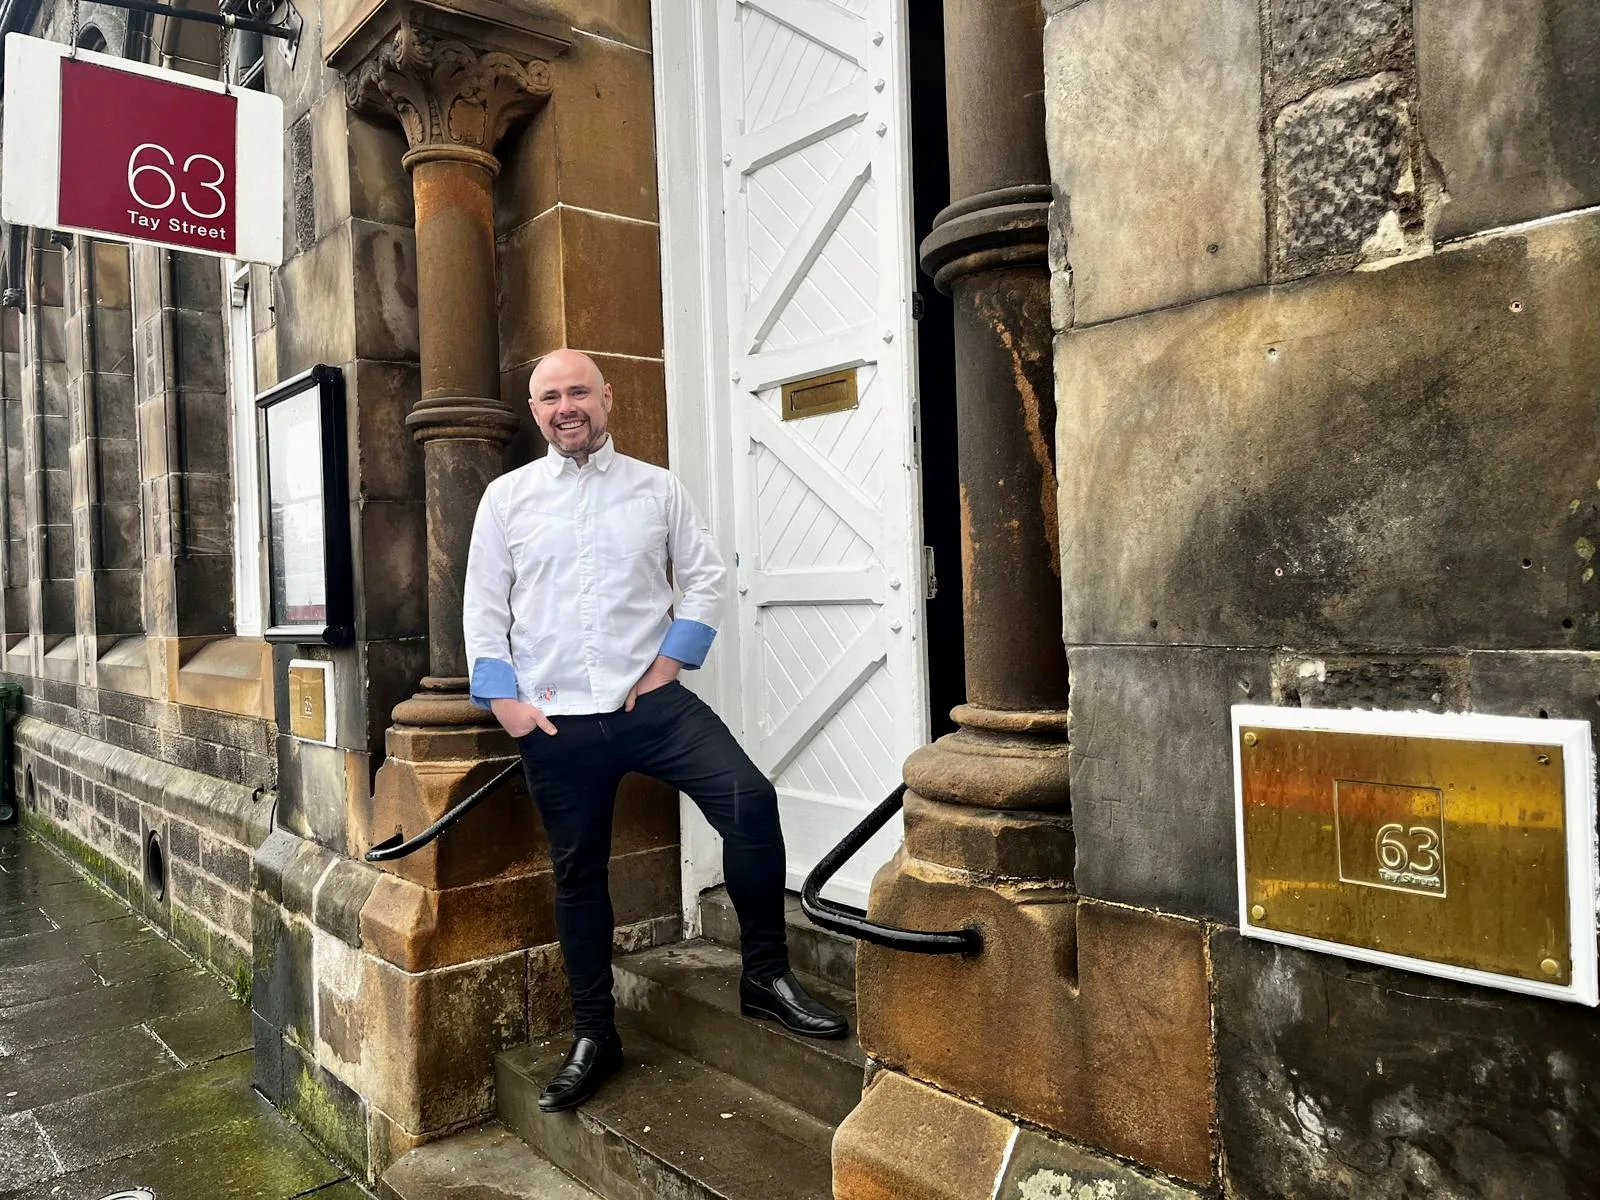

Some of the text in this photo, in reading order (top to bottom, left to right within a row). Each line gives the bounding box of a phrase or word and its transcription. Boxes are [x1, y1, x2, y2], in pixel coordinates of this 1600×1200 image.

[127, 143, 226, 218] 63
[127, 210, 226, 240] Tay Street
[1375, 823, 1441, 876] 63
[1379, 868, 1441, 887] Tay Street
